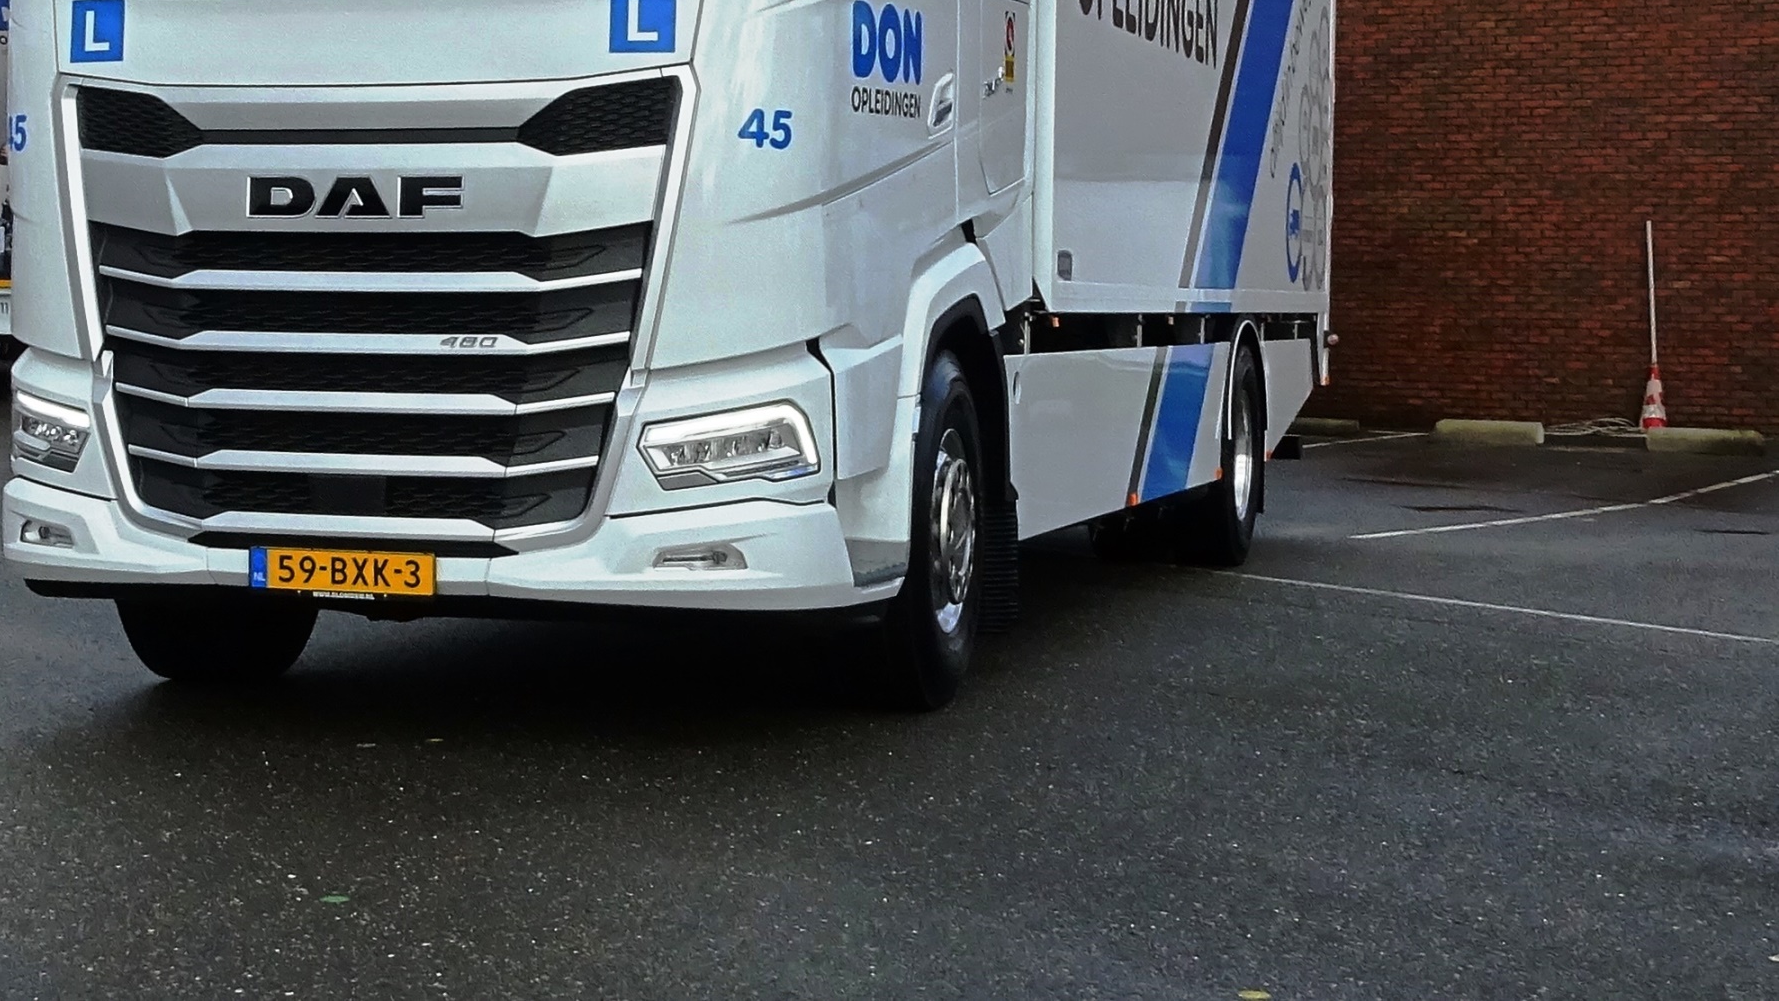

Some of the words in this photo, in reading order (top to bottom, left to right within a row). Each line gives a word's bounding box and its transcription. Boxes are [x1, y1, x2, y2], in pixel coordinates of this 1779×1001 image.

[84, 10, 110, 52] L
[852, 0, 922, 86] DON
[850, 85, 922, 119] OPLEIDINGEN
[738, 108, 793, 150] 45
[246, 175, 465, 219] DAF
[440, 336, 498, 349] 480
[253, 571, 266, 582] NL
[278, 554, 422, 589] 59-BXK-3
